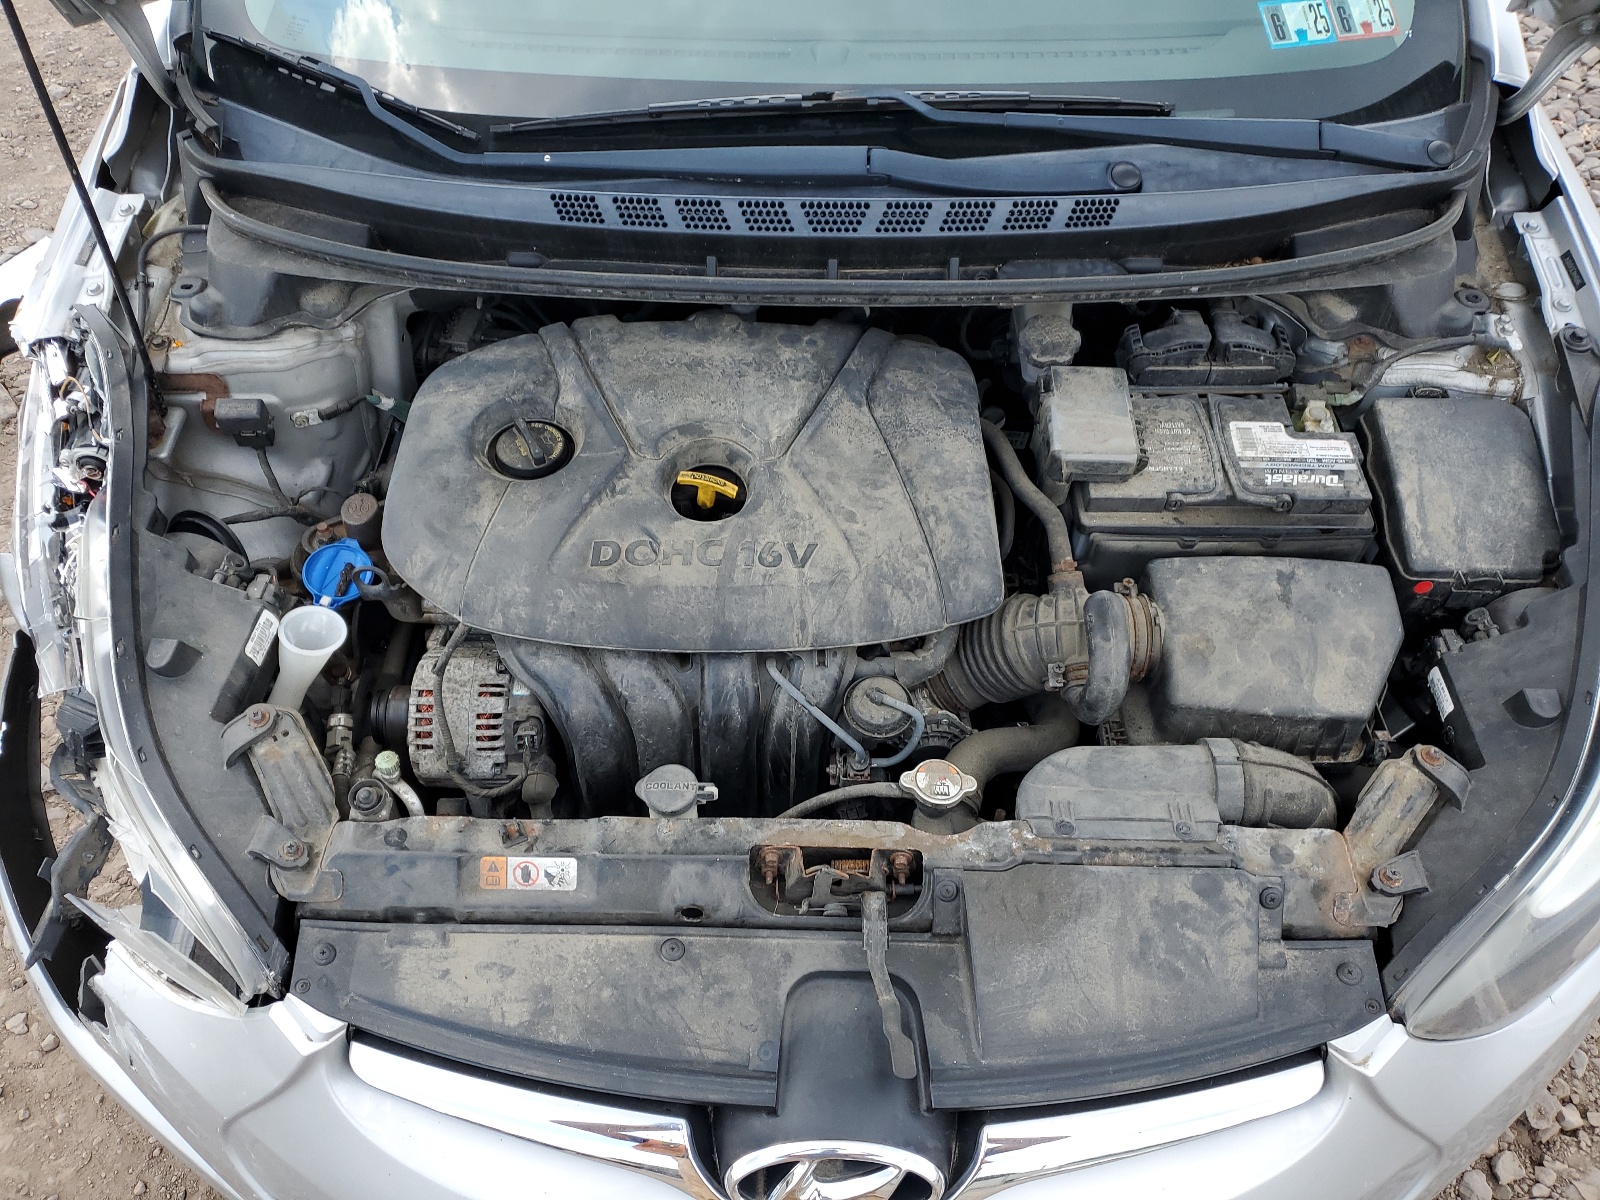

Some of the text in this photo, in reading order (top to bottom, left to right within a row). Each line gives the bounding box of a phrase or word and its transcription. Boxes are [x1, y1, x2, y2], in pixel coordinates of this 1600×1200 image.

[1270, 13, 1287, 41] 6
[1308, 3, 1331, 35] 25
[1336, 5, 1352, 33] 6
[1374, 0, 1395, 28] 25
[1264, 473, 1344, 487] Duralast
[590, 539, 819, 569] DOHC 16V
[645, 782, 697, 791] COOLANT
